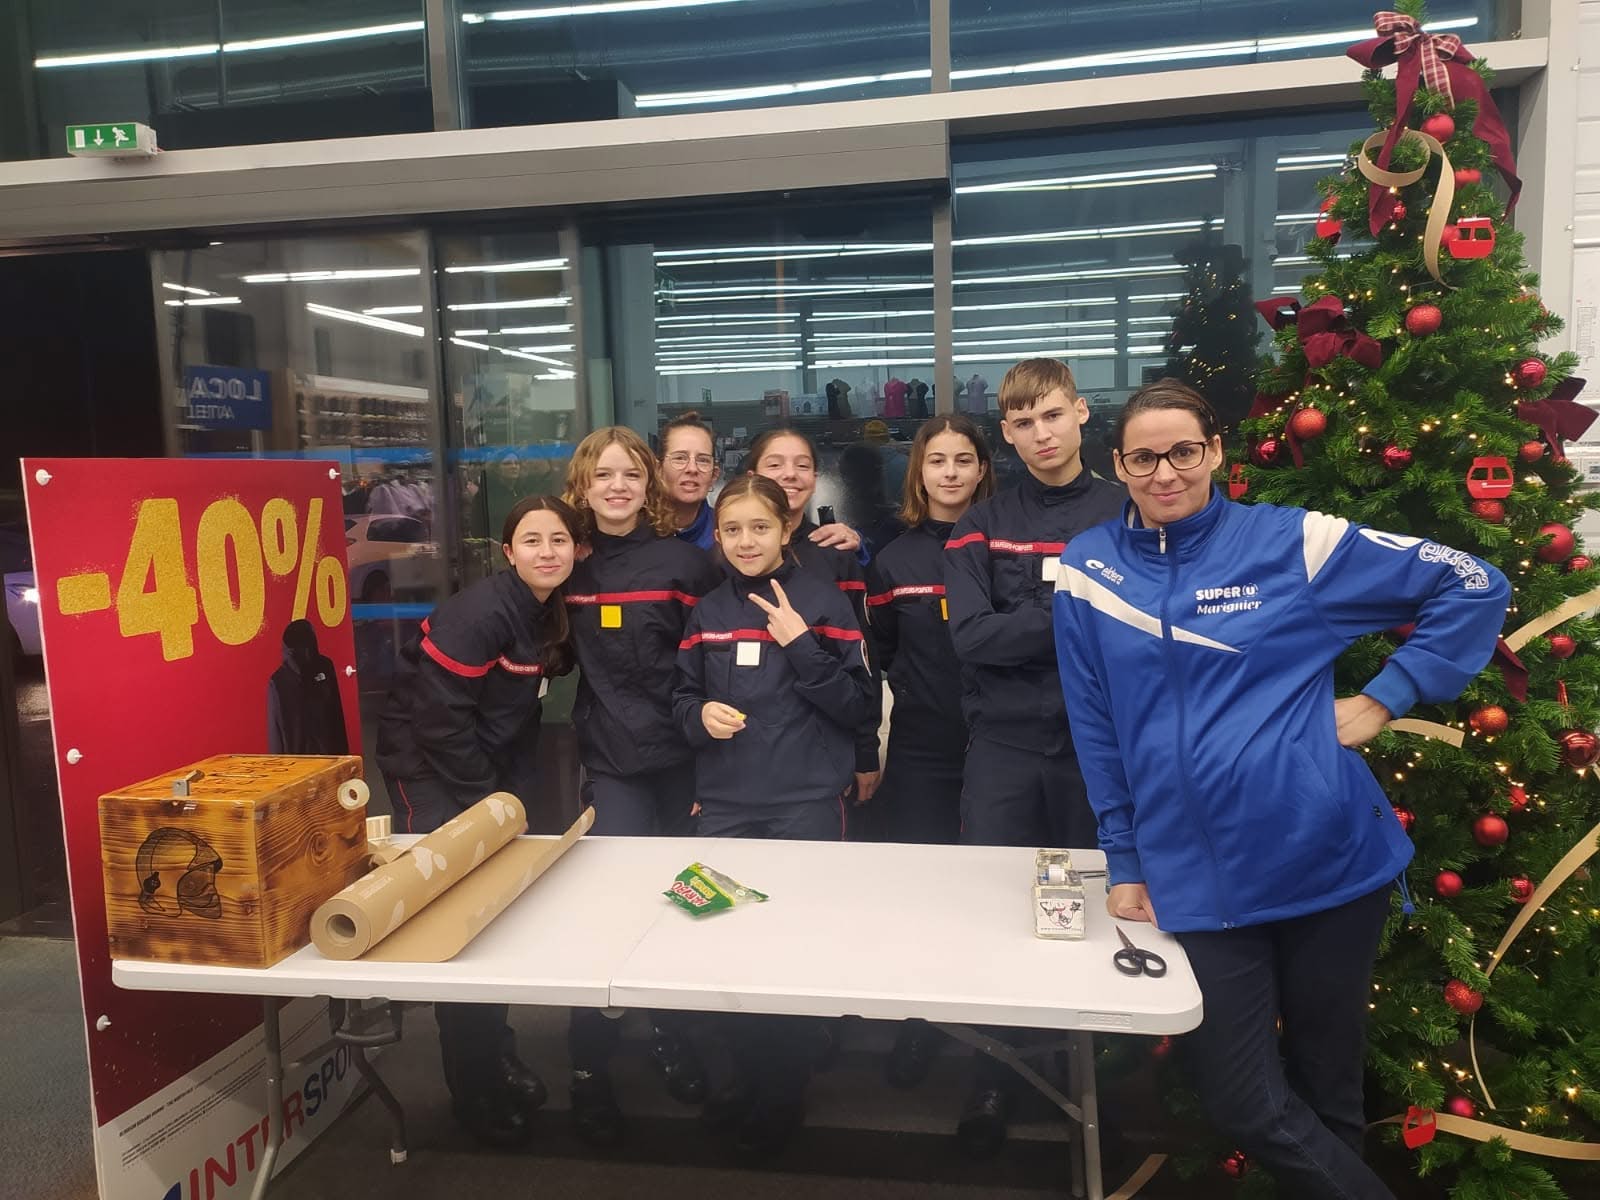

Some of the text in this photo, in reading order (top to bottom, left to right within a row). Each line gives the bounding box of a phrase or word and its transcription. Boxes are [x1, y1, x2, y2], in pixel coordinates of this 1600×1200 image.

[56, 496, 347, 662] -40%
[1195, 586, 1241, 601] SUPER
[1196, 600, 1262, 615] Marignier
